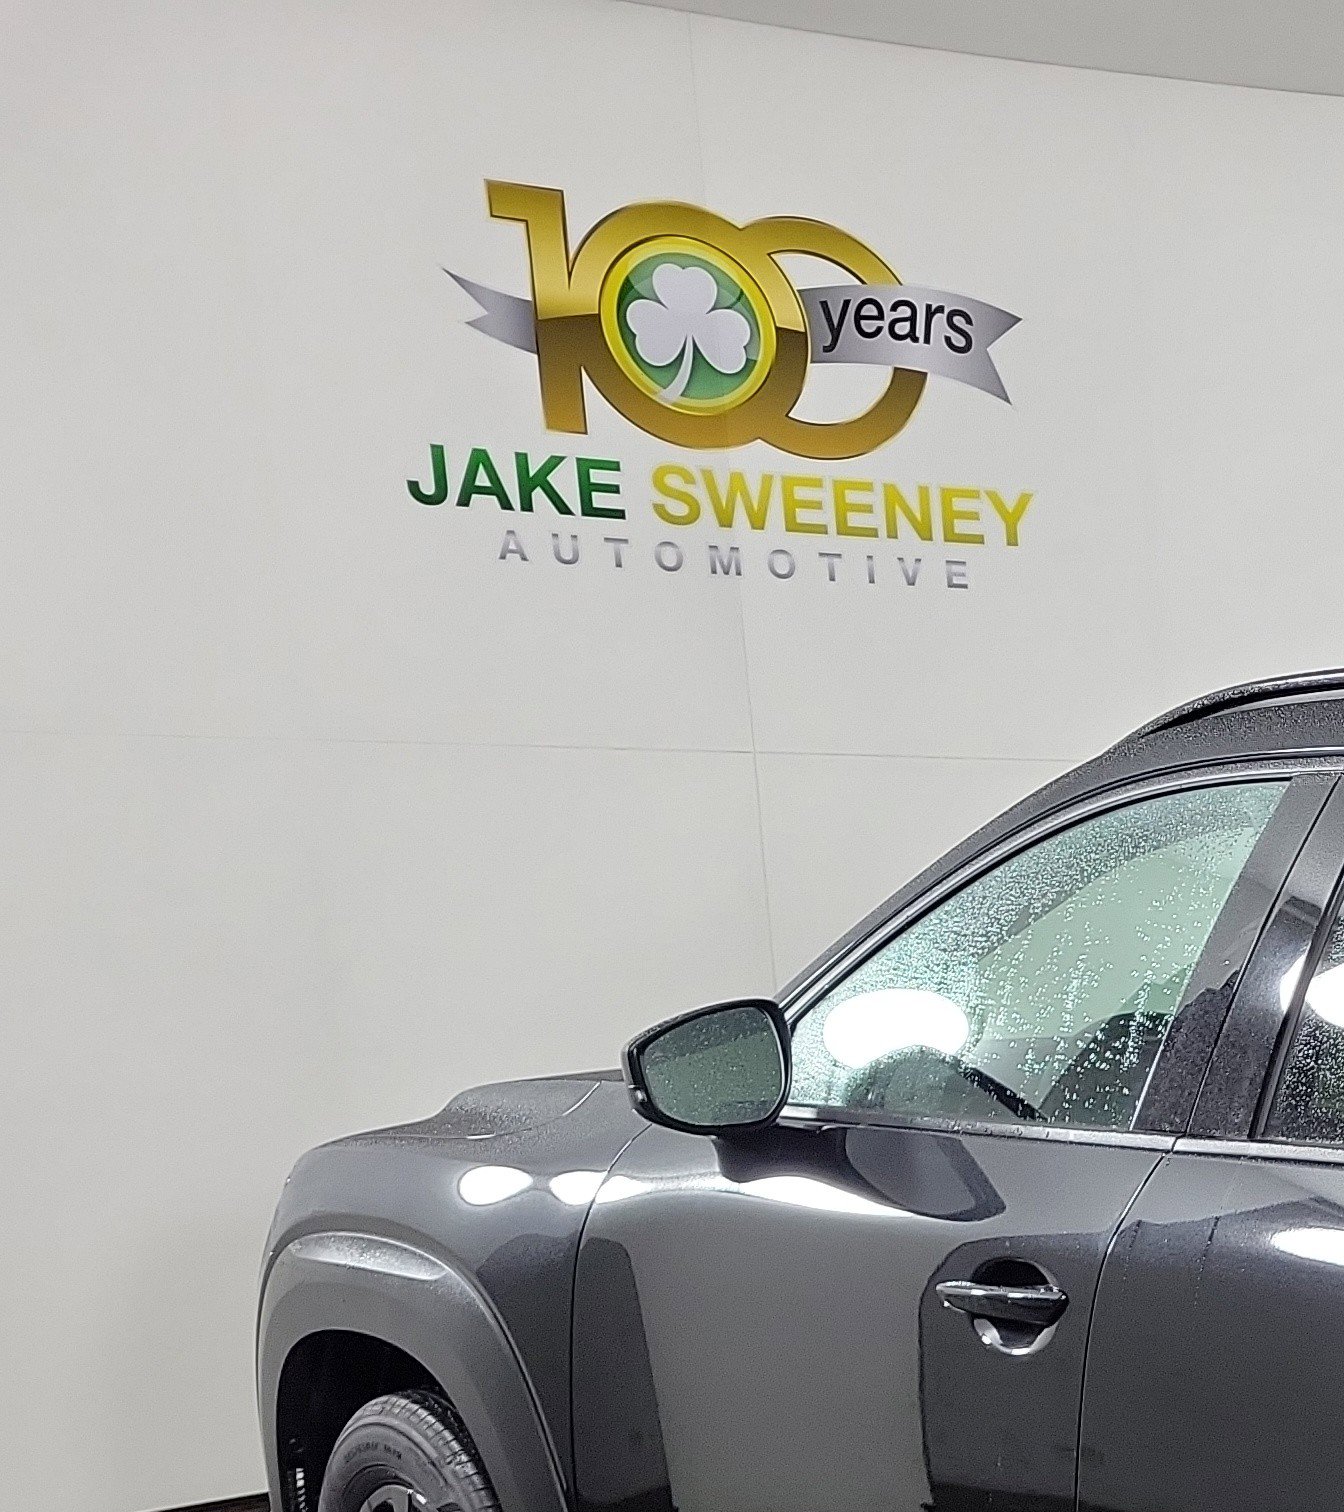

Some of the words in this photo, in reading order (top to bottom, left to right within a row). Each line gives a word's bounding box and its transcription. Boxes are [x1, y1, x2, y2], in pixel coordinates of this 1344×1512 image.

[484, 178, 927, 459] 100
[820, 297, 974, 354] years
[406, 443, 627, 520] JAKE
[651, 464, 1034, 547] SWEENEY
[498, 529, 970, 589] AUTOMOTIVE
